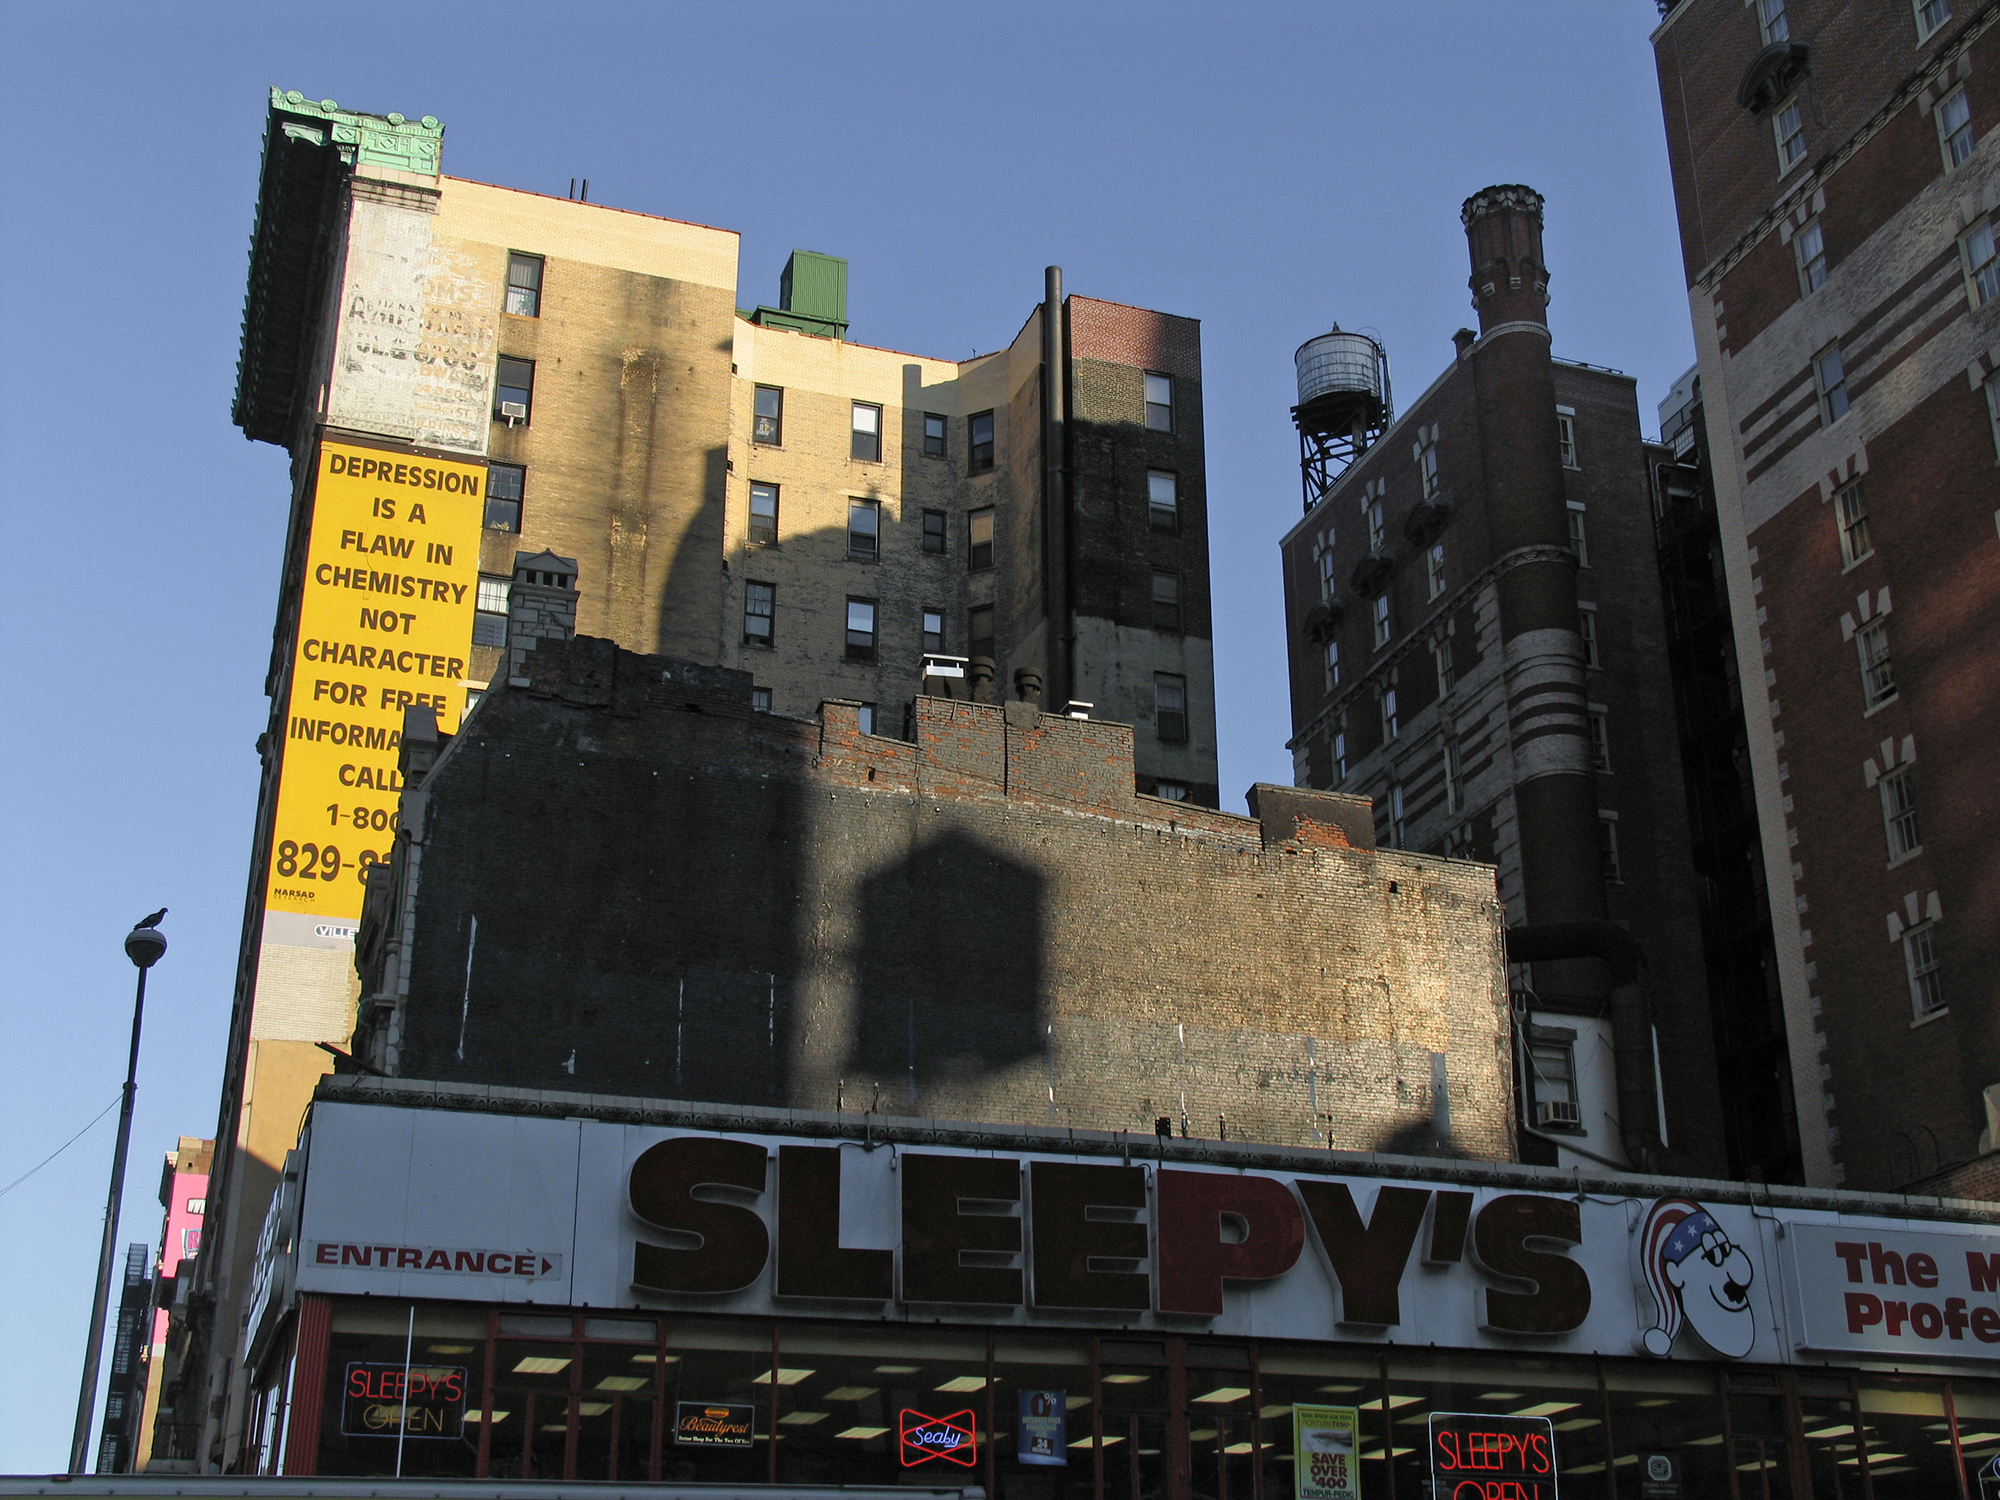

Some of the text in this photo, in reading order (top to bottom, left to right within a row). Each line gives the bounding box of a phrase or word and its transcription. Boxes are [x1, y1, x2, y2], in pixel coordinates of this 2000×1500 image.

[329, 453, 479, 497] DEPRESSION
[372, 497, 426, 524] IS A
[340, 529, 453, 566] FLAW IN
[315, 563, 468, 605] CHEMISTRY
[359, 608, 416, 635] NOT
[303, 638, 464, 680] CHARACTER
[313, 679, 367, 707] FOR
[338, 763, 403, 793] CALL
[274, 888, 315, 899] NARSAD
[629, 1137, 1592, 1336] SLEEPY'S
[316, 1243, 536, 1276] ENTRANCE
[1835, 1242, 1939, 1288] The
[1844, 1292, 2000, 1344] Profe
[349, 1370, 462, 1402] SLEEPY'S
[363, 1404, 443, 1432] OPEN
[679, 1416, 751, 1438] Beautyrest
[913, 1426, 961, 1448] Sealy
[1037, 1438, 1048, 1448] 24
[1312, 1453, 1346, 1466] SAVE
[1437, 1431, 1550, 1473] SLEEPY'S
[1310, 1465, 1347, 1477] OVER
[1312, 1476, 1347, 1489] $400
[1303, 1488, 1354, 1499] TEMPUR-PEDIC
